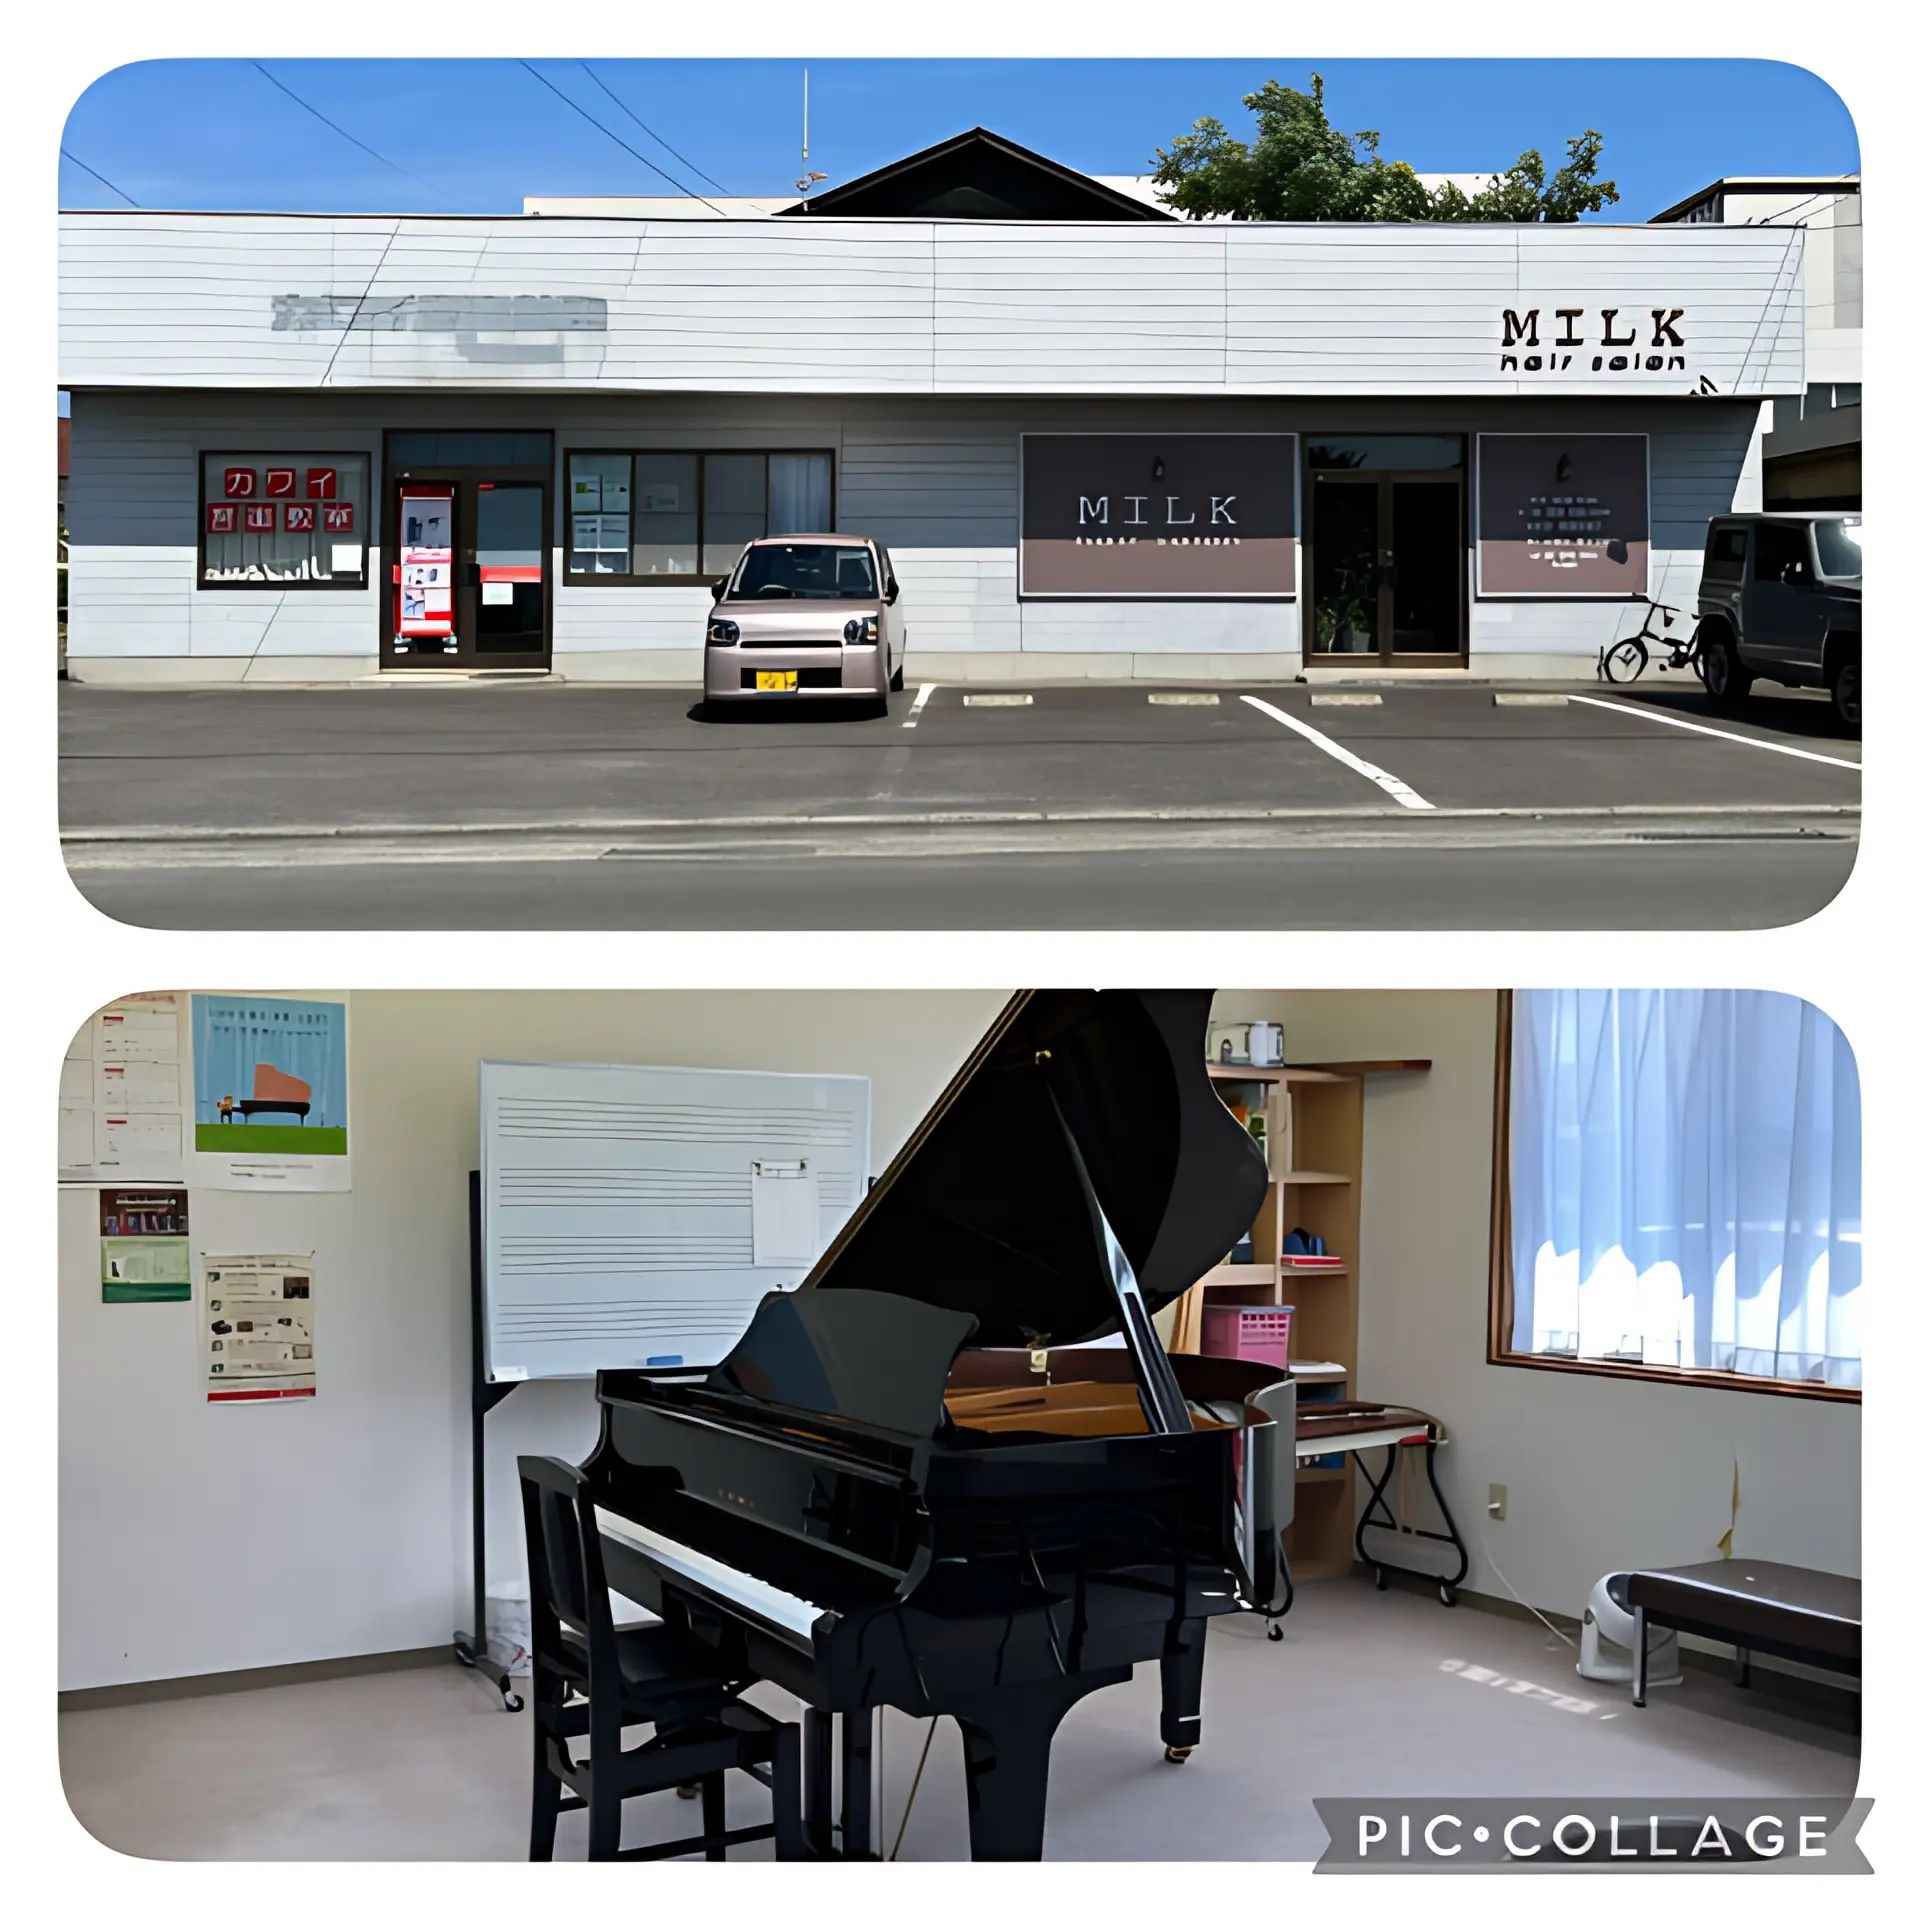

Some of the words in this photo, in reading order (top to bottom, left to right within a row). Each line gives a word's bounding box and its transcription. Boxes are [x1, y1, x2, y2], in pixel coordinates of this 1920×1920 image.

[1501, 308, 1685, 347] MILK
[226, 470, 334, 498] カワイ
[1079, 496, 1237, 524] MILK
